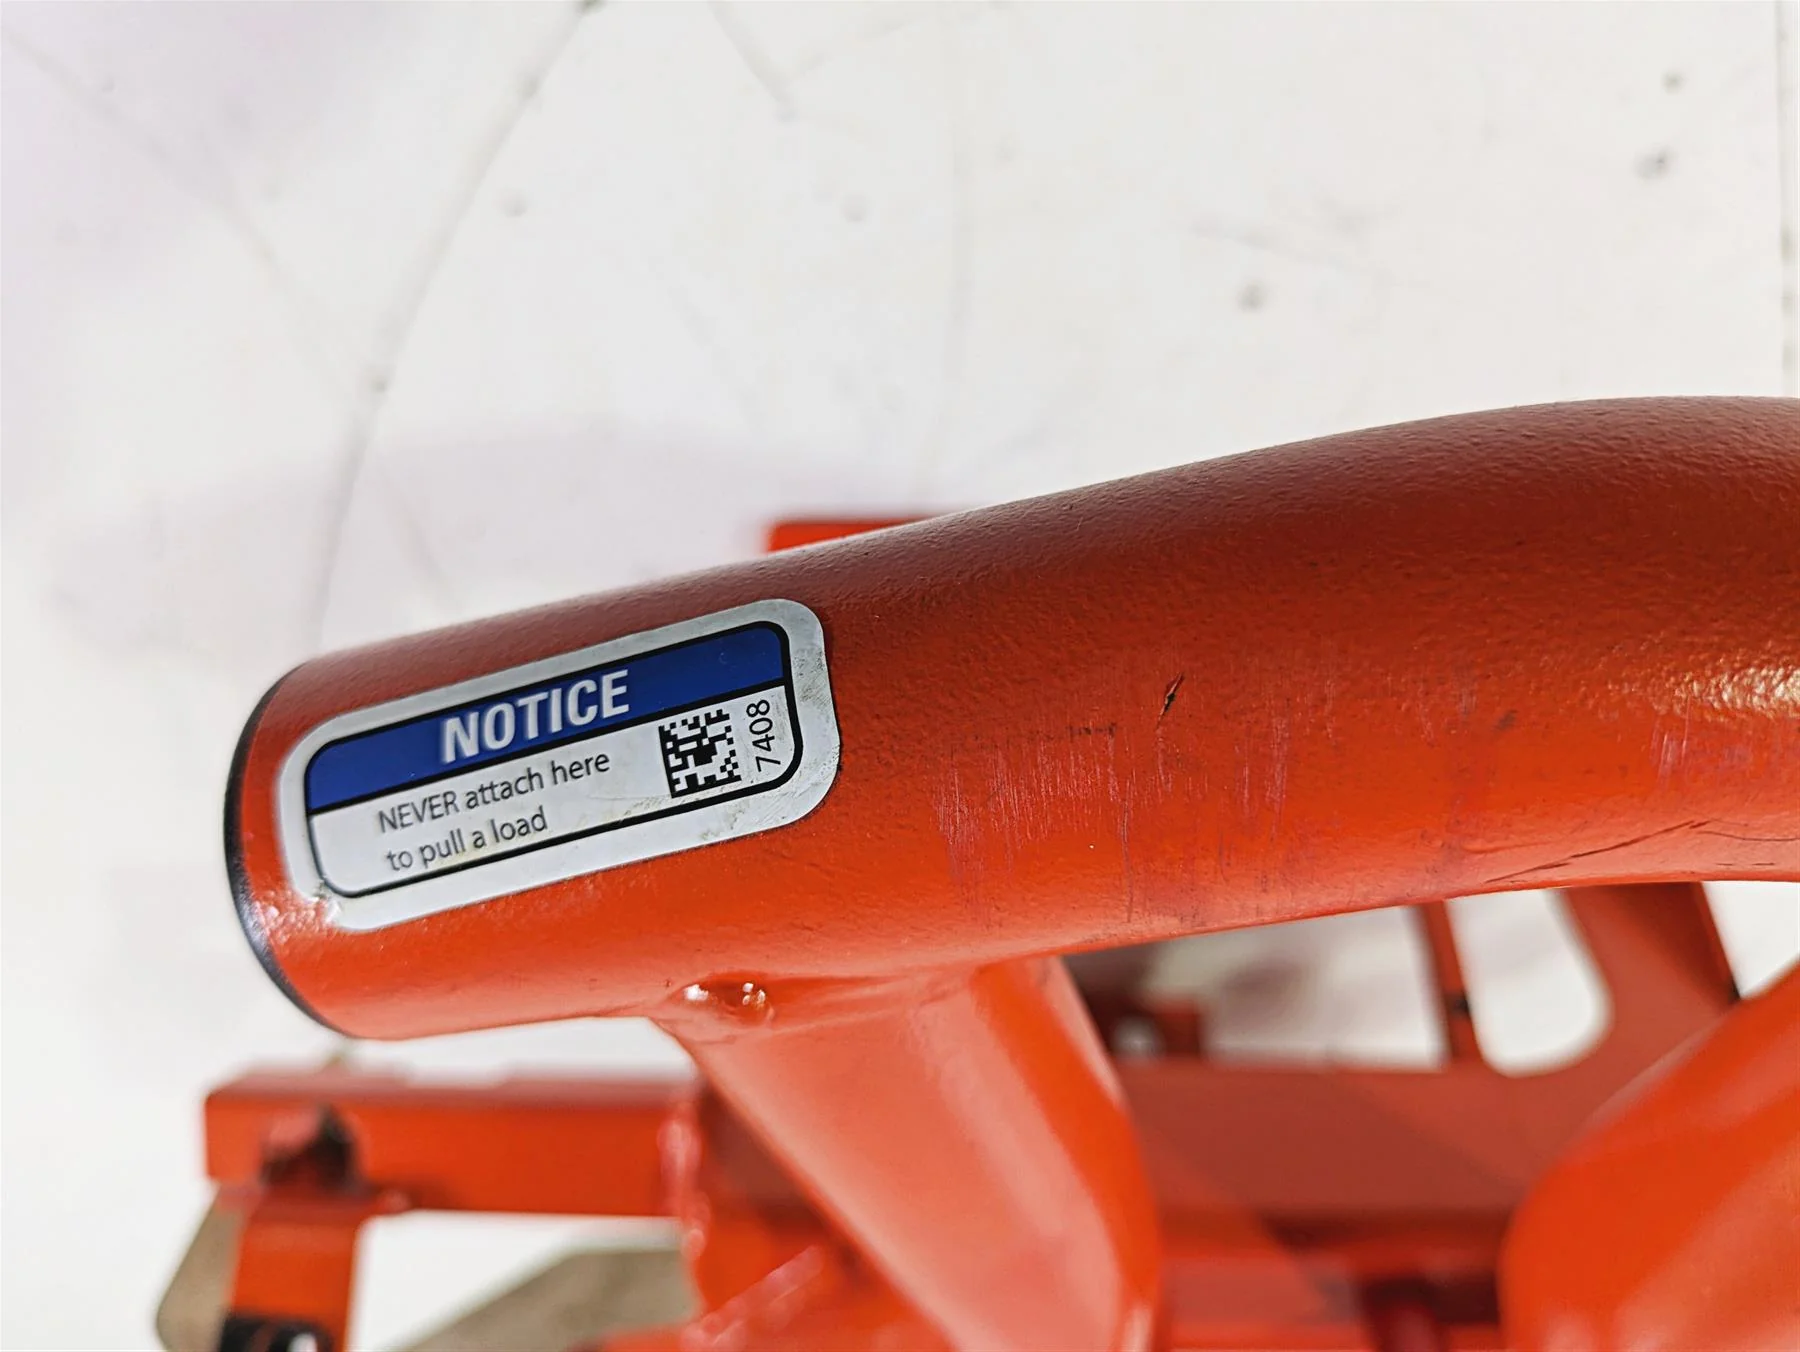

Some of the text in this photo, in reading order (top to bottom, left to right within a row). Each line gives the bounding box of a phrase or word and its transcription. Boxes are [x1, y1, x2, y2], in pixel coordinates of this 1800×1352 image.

[441, 668, 630, 764] NOTICE
[746, 699, 782, 774] 7408
[378, 751, 611, 834] NEVER attach here
[387, 806, 548, 873] to pull a load
